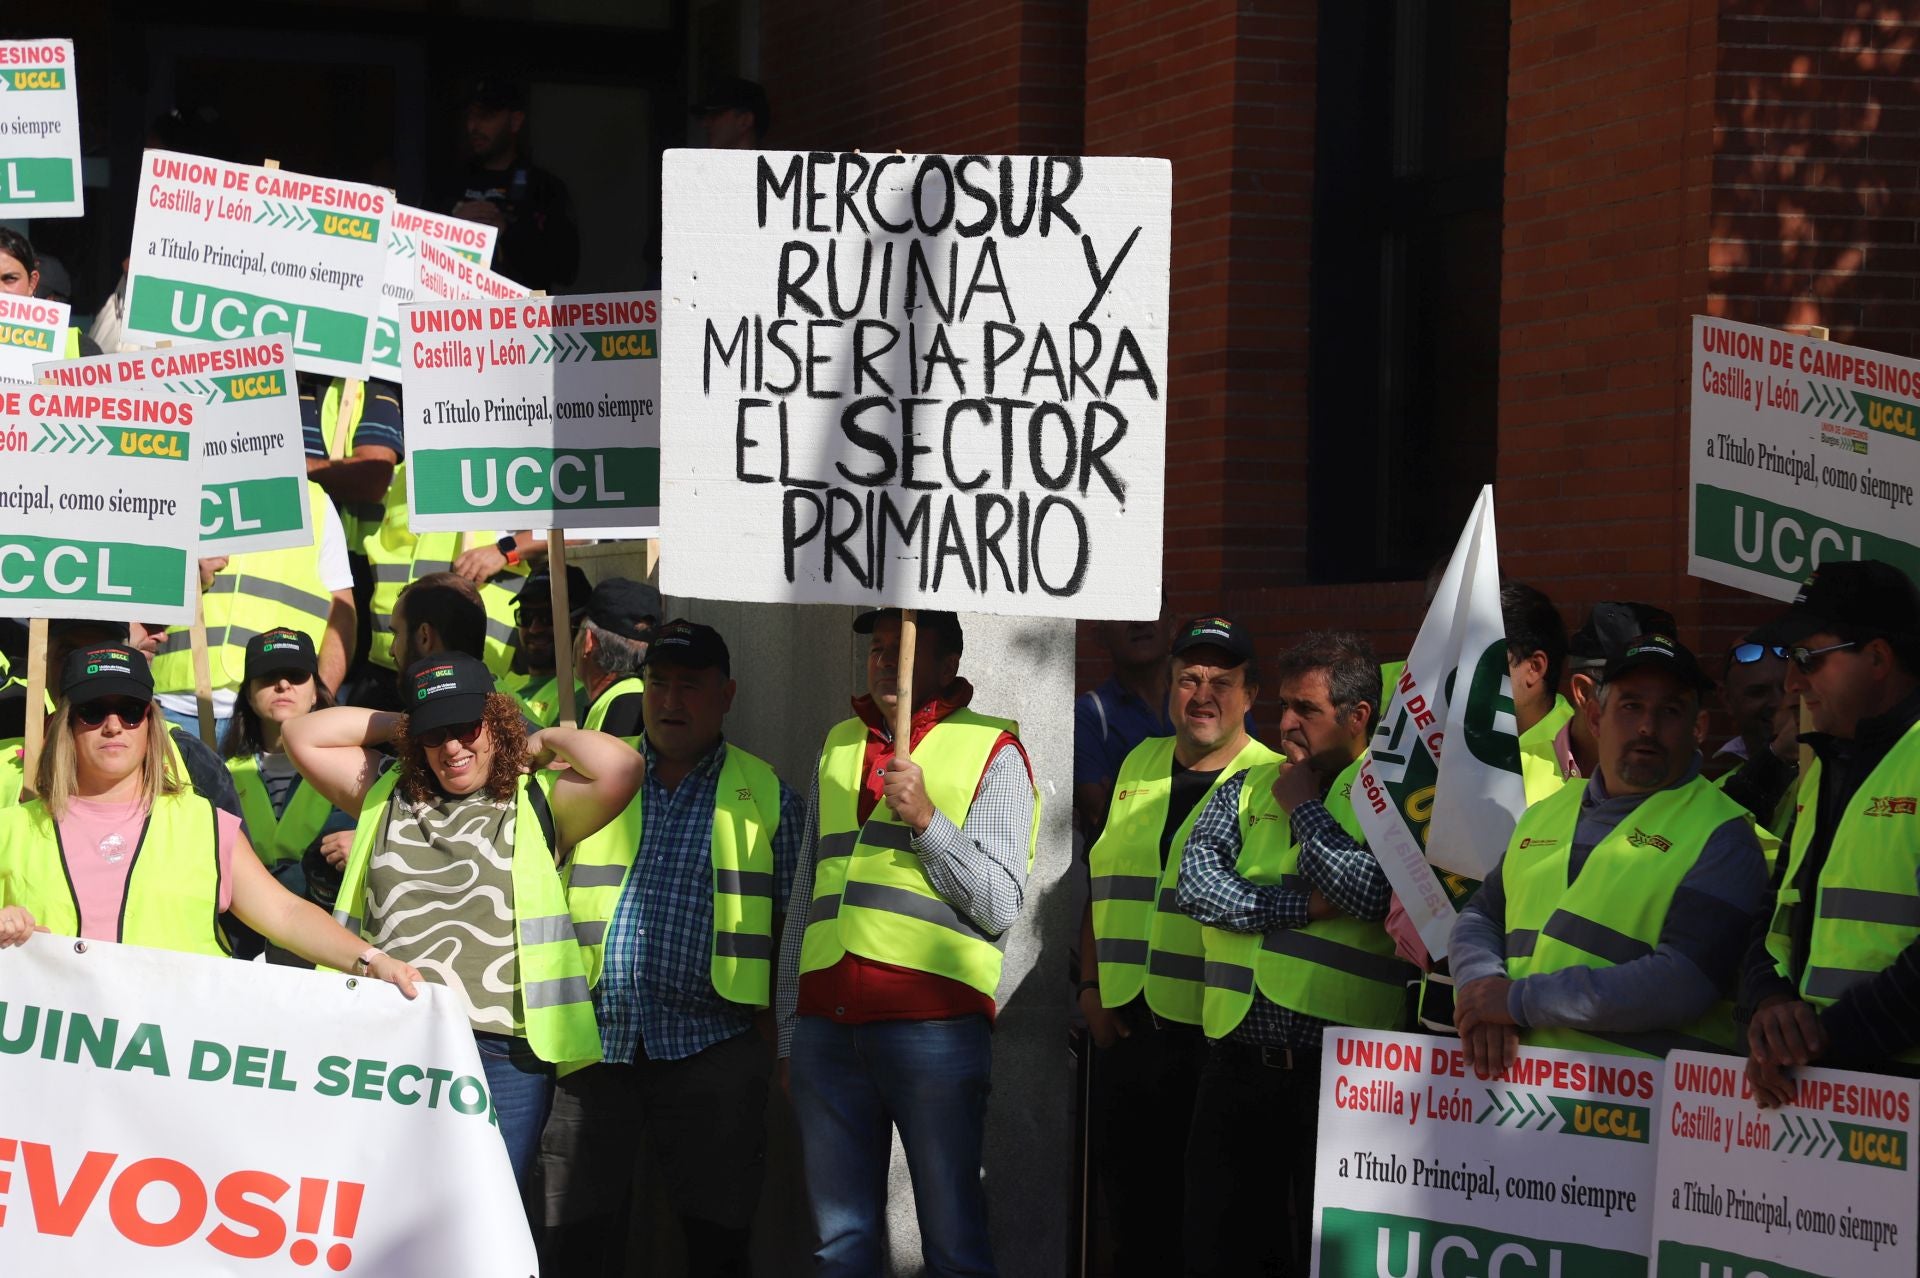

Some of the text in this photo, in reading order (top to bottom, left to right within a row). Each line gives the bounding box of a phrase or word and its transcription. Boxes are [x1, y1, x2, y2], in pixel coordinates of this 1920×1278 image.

[14, 71, 61, 90] UCCL
[12, 116, 61, 138] siempre
[150, 184, 252, 223] Castilla y León
[152, 158, 385, 214] UNION DE CAMPESINOS
[757, 153, 1085, 237] MERCOSUR
[323, 214, 373, 241] UCCL
[149, 237, 364, 291] a Título Principal, como siempre
[420, 264, 447, 299] Castilla
[421, 240, 455, 275] UNION
[458, 262, 473, 285] DE
[777, 225, 1143, 323] RUINA Y
[382, 283, 414, 301] como
[171, 290, 322, 352] UCCL
[410, 300, 657, 334] UNION DE CAMPESINOS
[118, 361, 147, 382] DE
[151, 343, 285, 378] CAMPESINOS
[413, 340, 472, 369] Castilla
[476, 346, 486, 373] y
[490, 337, 526, 366] León
[601, 334, 652, 359] UCCL
[704, 314, 1160, 401] MISERIA PARA
[1703, 326, 1920, 400] UNION DE CAMPESINOS
[231, 375, 280, 400] UCCL
[1702, 361, 1799, 412] Castilla y León
[0, 392, 193, 426] E CAMPESINOS
[423, 393, 654, 427] a Título Principal, como siempre
[1868, 401, 1917, 436] UCCL
[120, 431, 182, 458] UCCL
[230, 432, 285, 455] siempre
[736, 396, 1130, 503] EL SECTOR
[460, 454, 626, 507] UCCL
[1707, 433, 1914, 509] a Título Principal, como siempre
[59, 492, 105, 511] como
[109, 488, 177, 521] siempre
[782, 488, 1090, 598] PRIMARIO
[1406, 695, 1436, 730] DE
[187, 1039, 297, 1092] DEL
[1336, 1038, 1421, 1073] UNION
[1431, 1047, 1465, 1078] DE
[1674, 1062, 1736, 1098] UNION
[1335, 1075, 1473, 1125] Castilla y León
[1574, 1104, 1641, 1138] UCCL
[1672, 1101, 1771, 1153] Castilla y León
[1849, 1130, 1902, 1166] UCCL
[1339, 1151, 1637, 1217] a Título Principal, como siempre
[1672, 1181, 1898, 1251] a Título Principal, como siempre
